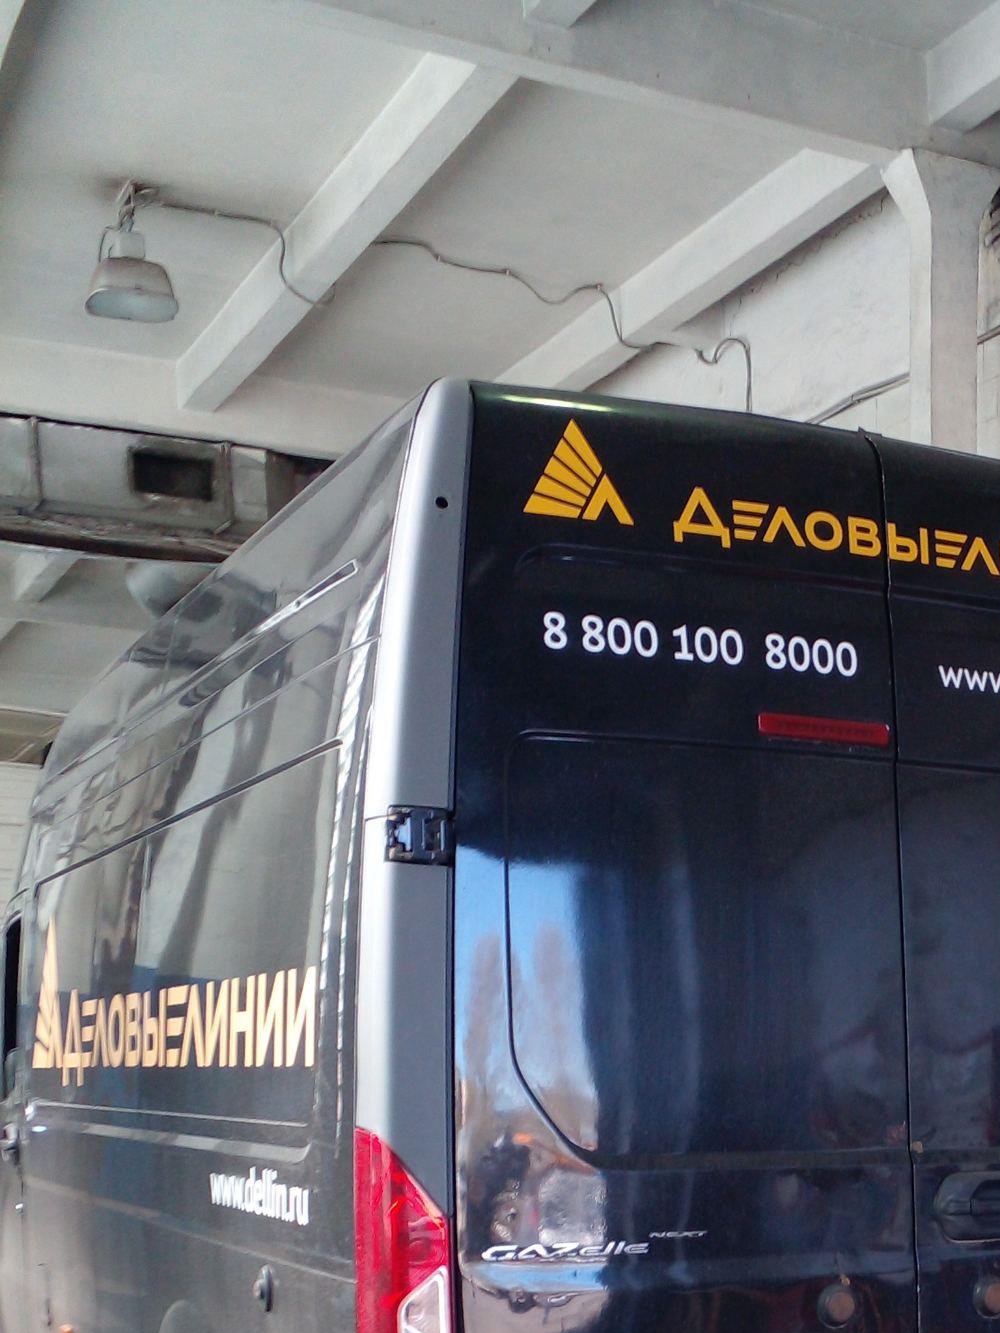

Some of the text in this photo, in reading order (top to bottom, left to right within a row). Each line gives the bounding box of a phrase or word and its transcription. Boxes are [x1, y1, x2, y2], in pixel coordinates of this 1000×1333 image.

[542, 611, 858, 678] 8 800 100 8000
[209, 1166, 309, 1226] www.dellin.ru
